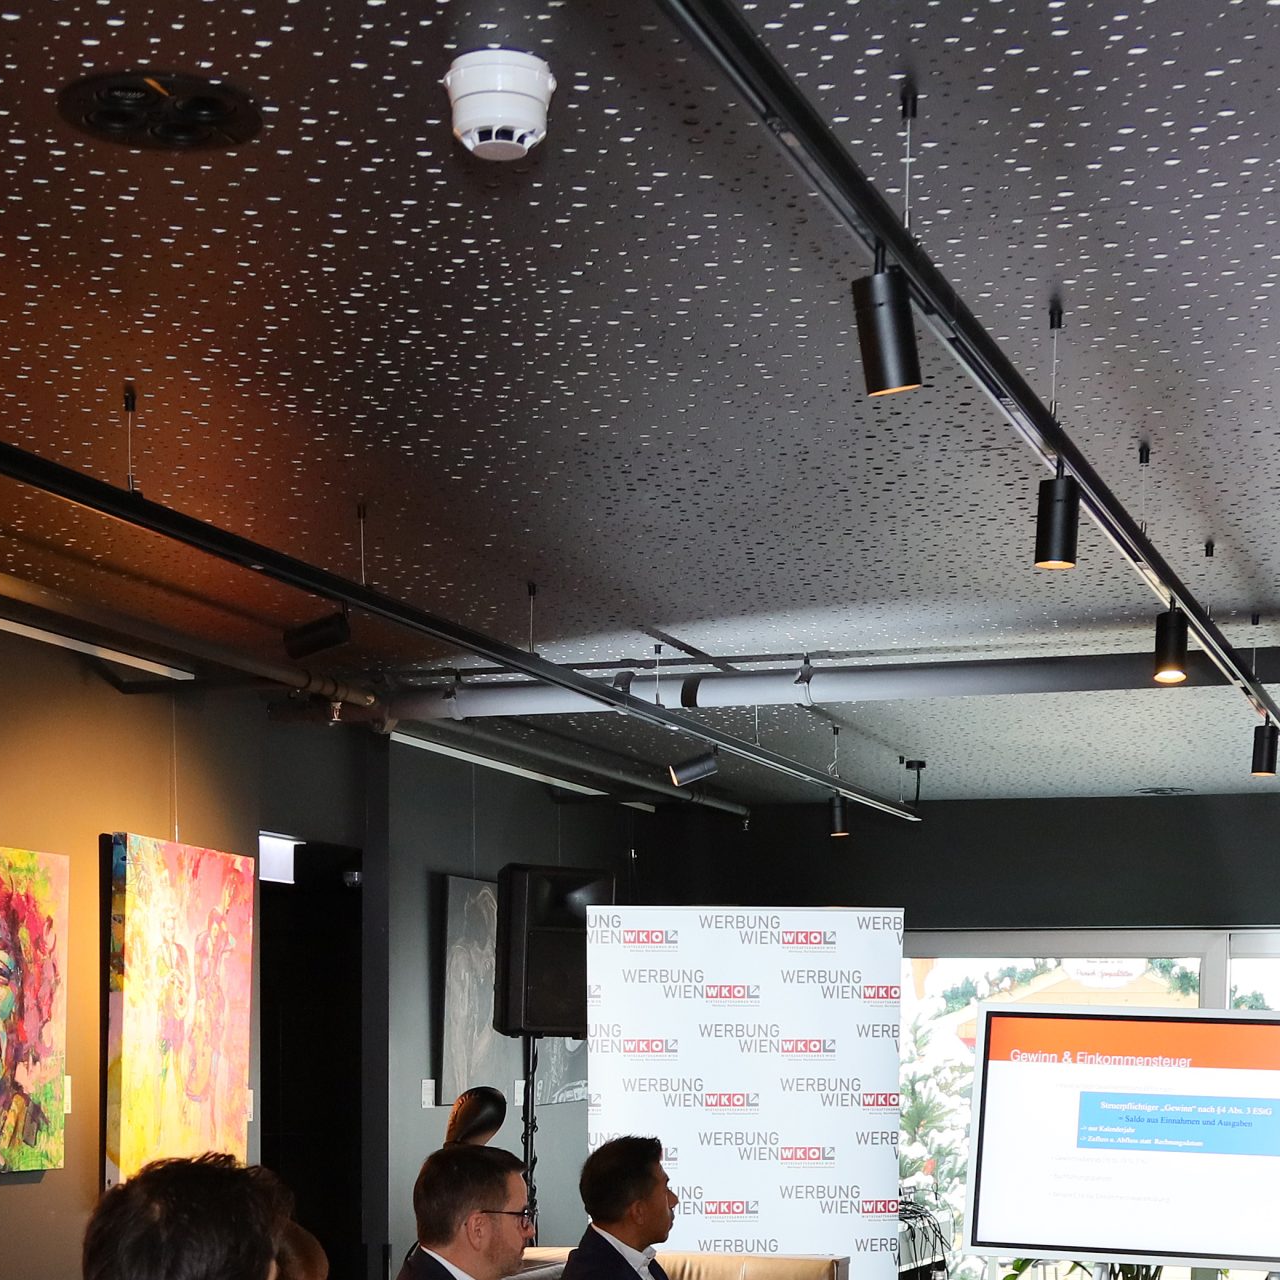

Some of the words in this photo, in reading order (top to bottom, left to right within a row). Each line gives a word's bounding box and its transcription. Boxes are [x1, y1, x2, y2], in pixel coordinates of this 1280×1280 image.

[698, 915, 781, 929] WERBUNG
[856, 916, 903, 930] WERB
[739, 930, 781, 945] WIEN
[621, 969, 705, 983] WERBUNG
[780, 969, 862, 984] WERBUNG
[662, 985, 704, 999] WIEN
[820, 985, 862, 999] WIEN
[863, 985, 900, 999] WKO
[698, 1023, 780, 1038] WERBUNG
[856, 1024, 900, 1038] WERB
[738, 1039, 780, 1053] WIEN
[1010, 1049, 1058, 1063] Gewinn
[1062, 1050, 1072, 1064] &
[1076, 1051, 1192, 1068] Einkommensteuer
[622, 1077, 704, 1092] WERBUNG
[780, 1077, 861, 1092] WERBUNG
[662, 1093, 704, 1107] WIEN
[820, 1093, 861, 1107] WIEN
[862, 1093, 899, 1107] WKO
[1100, 1101, 1159, 1112] Steuerpflichtiger
[1197, 1105, 1215, 1114] nach
[1125, 1115, 1145, 1124] Saldo
[1160, 1117, 1200, 1126] Einnahmen
[1202, 1118, 1216, 1127] und
[1217, 1119, 1253, 1129] Ausgaben
[698, 1131, 779, 1146] WERBUNG
[855, 1131, 899, 1145] WERB
[738, 1147, 779, 1161] WIEN
[779, 1185, 861, 1199] WERBUNG
[677, 1201, 704, 1215] IEN
[820, 1200, 860, 1214] WIEN
[861, 1200, 898, 1214] WKO
[697, 1239, 779, 1253] WERBUNG
[855, 1238, 898, 1252] WERB
